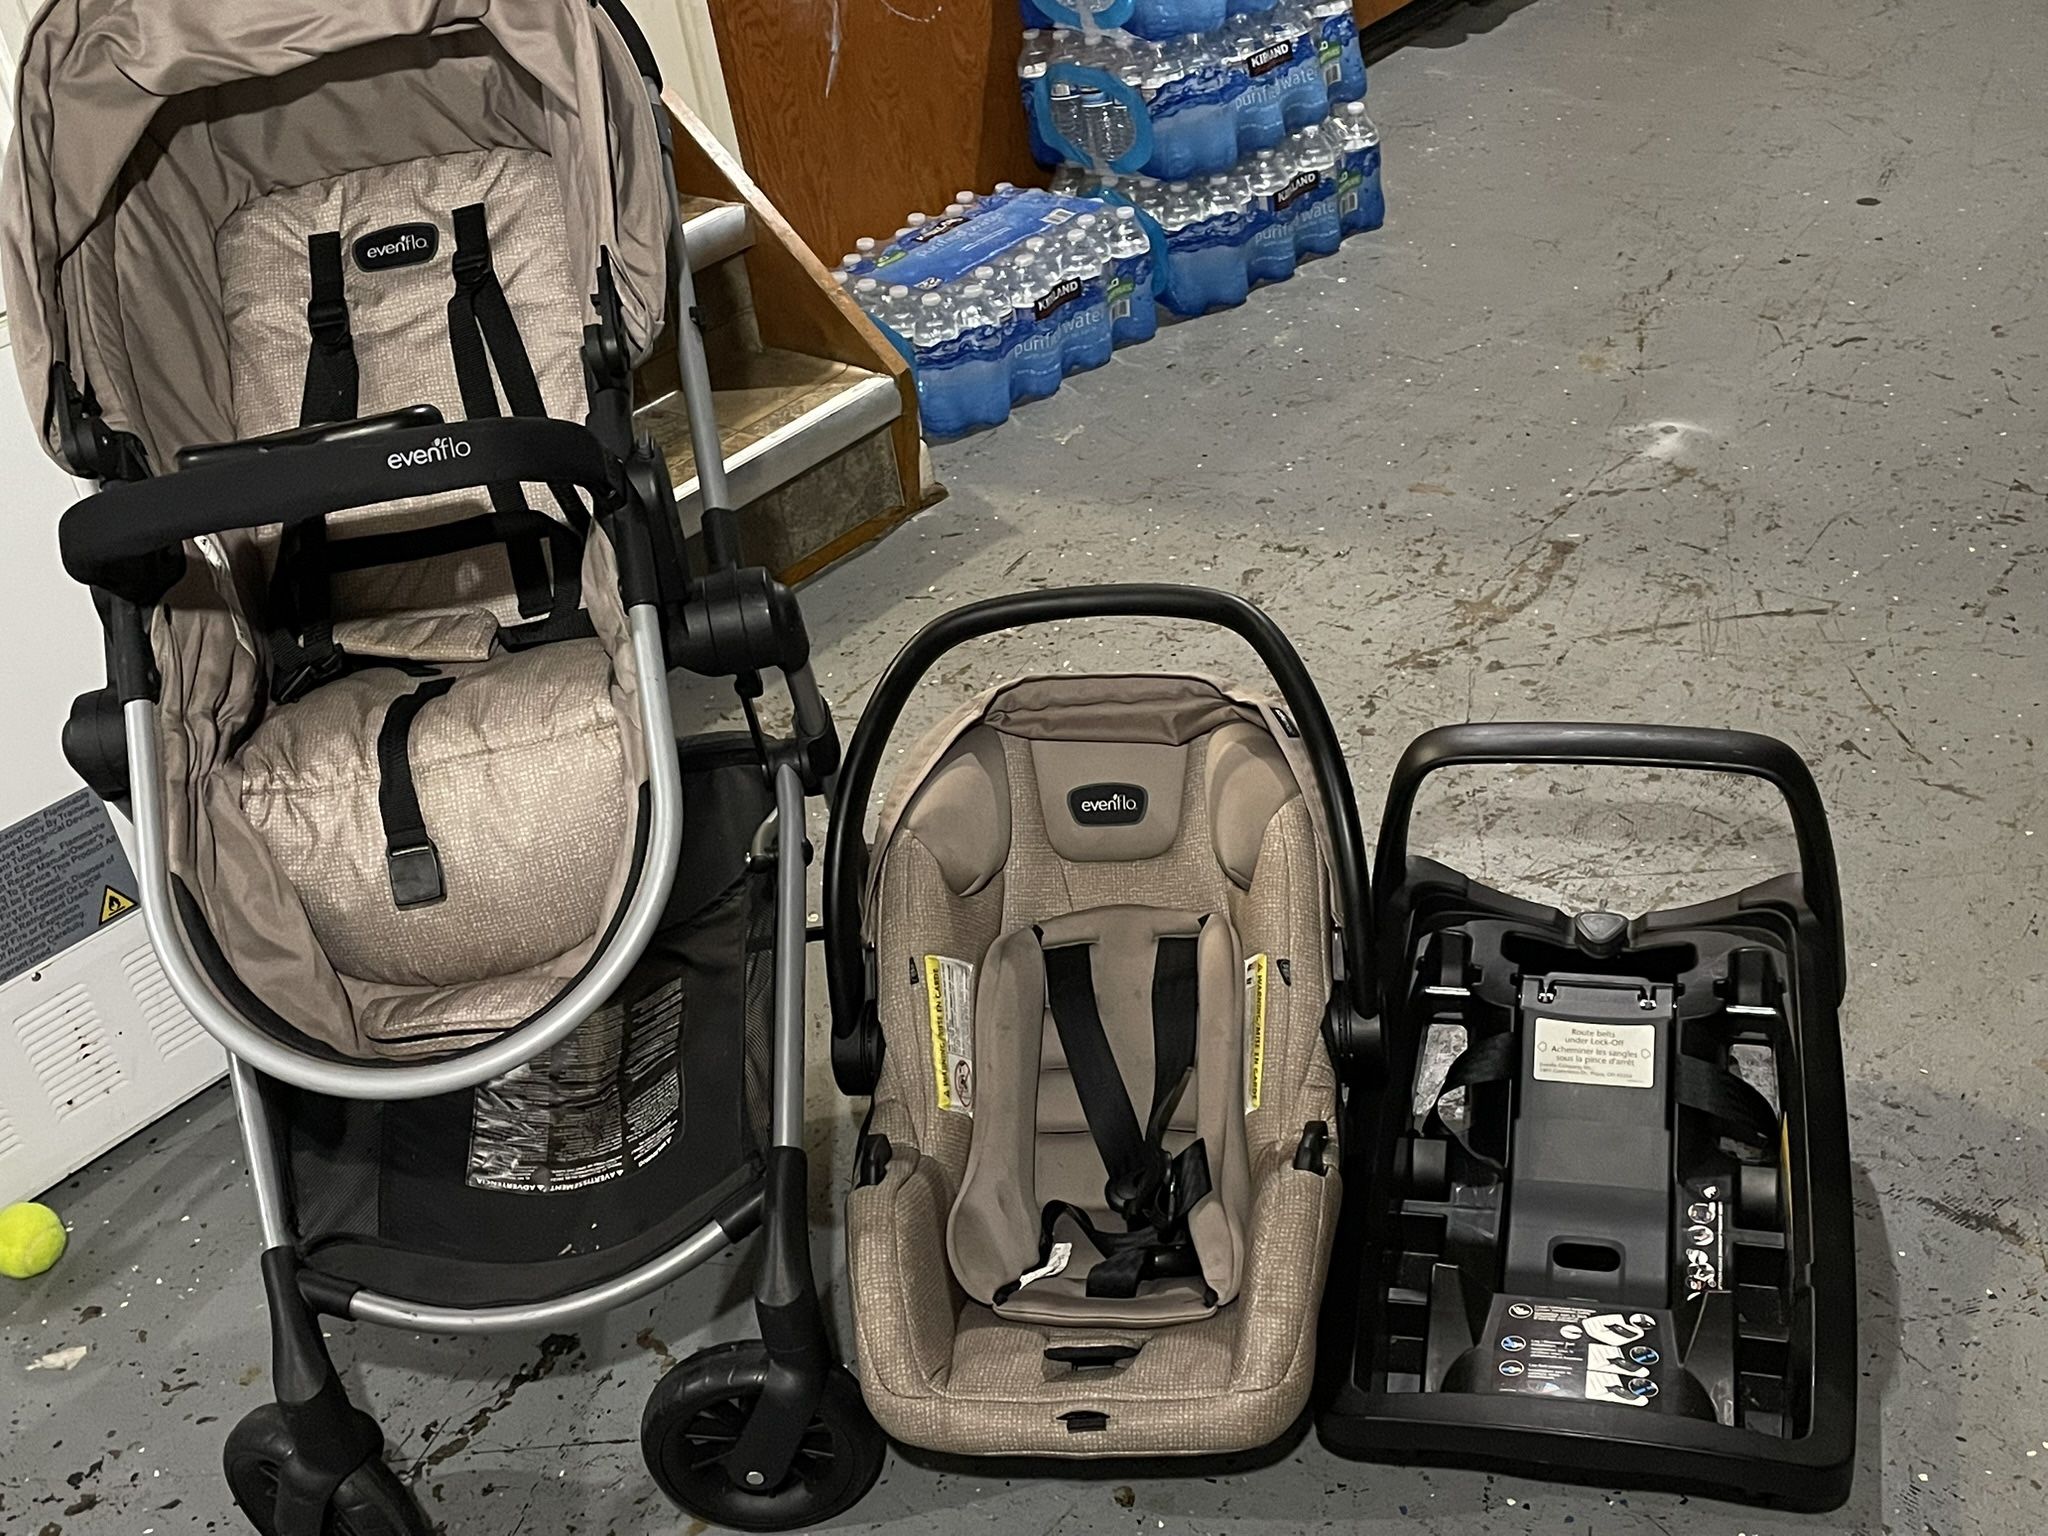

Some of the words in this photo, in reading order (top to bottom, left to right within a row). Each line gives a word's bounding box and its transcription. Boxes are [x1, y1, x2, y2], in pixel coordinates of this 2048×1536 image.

[366, 234, 427, 259] evenflo
[387, 437, 471, 470] evenflo
[1081, 794, 1137, 812] evenflo
[1591, 1038, 1624, 1046] Lock-Off
